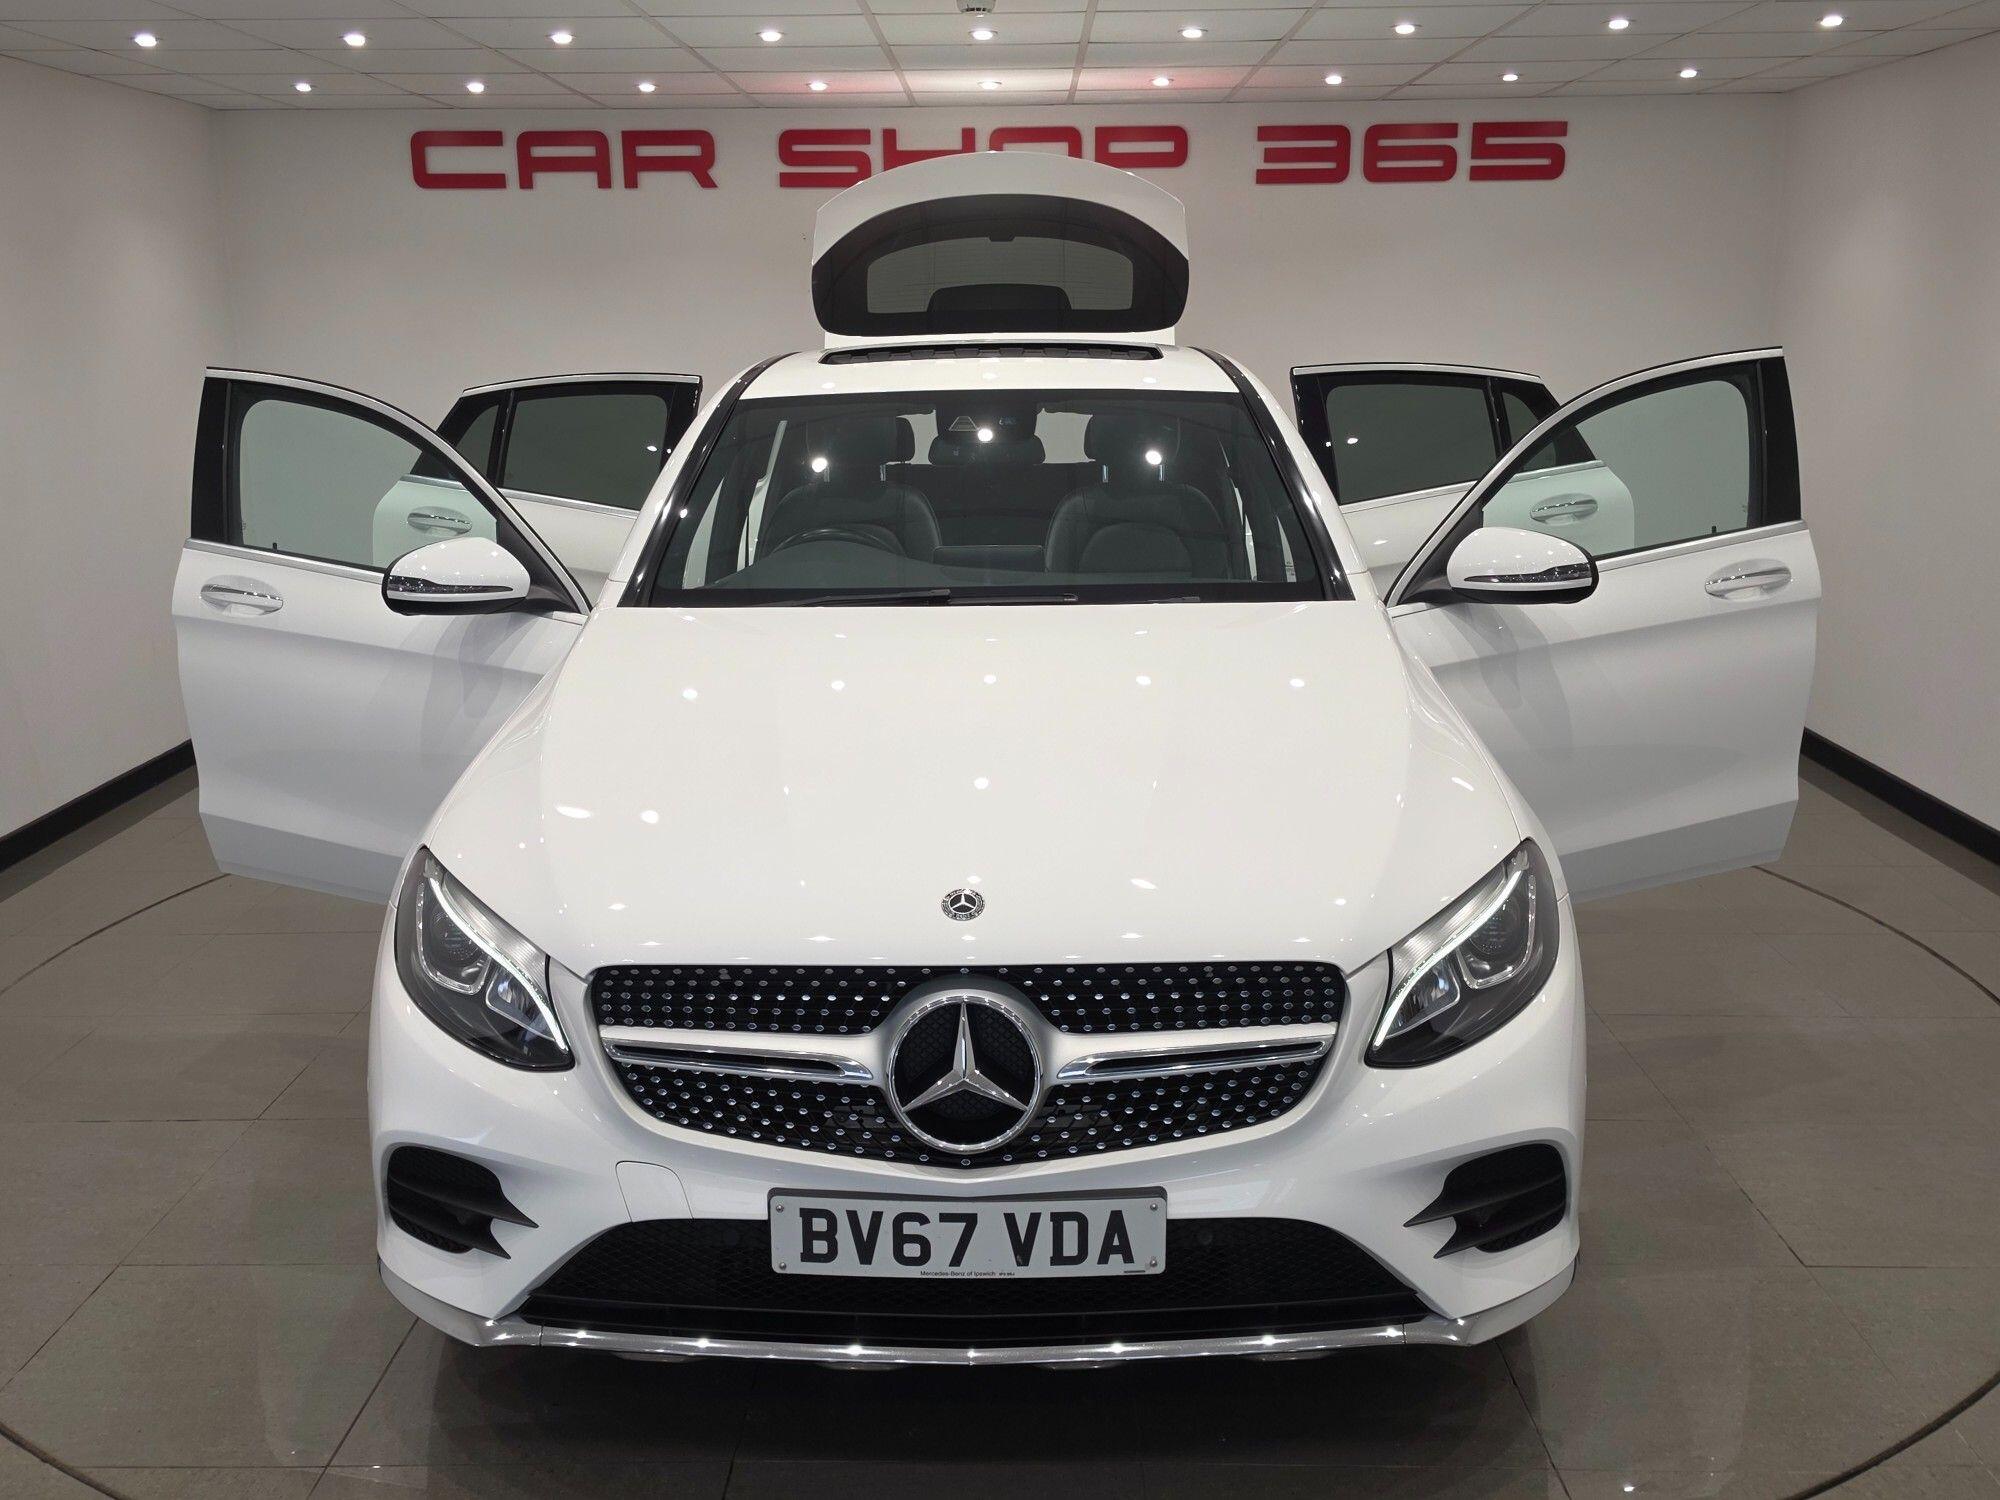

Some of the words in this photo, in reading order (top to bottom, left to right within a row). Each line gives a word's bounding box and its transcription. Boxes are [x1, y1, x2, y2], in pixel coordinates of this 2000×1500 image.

[410, 130, 718, 189] CAR
[1256, 121, 1568, 184] 365
[799, 1207, 978, 1267] BV67
[1003, 1209, 1135, 1267] VDA
